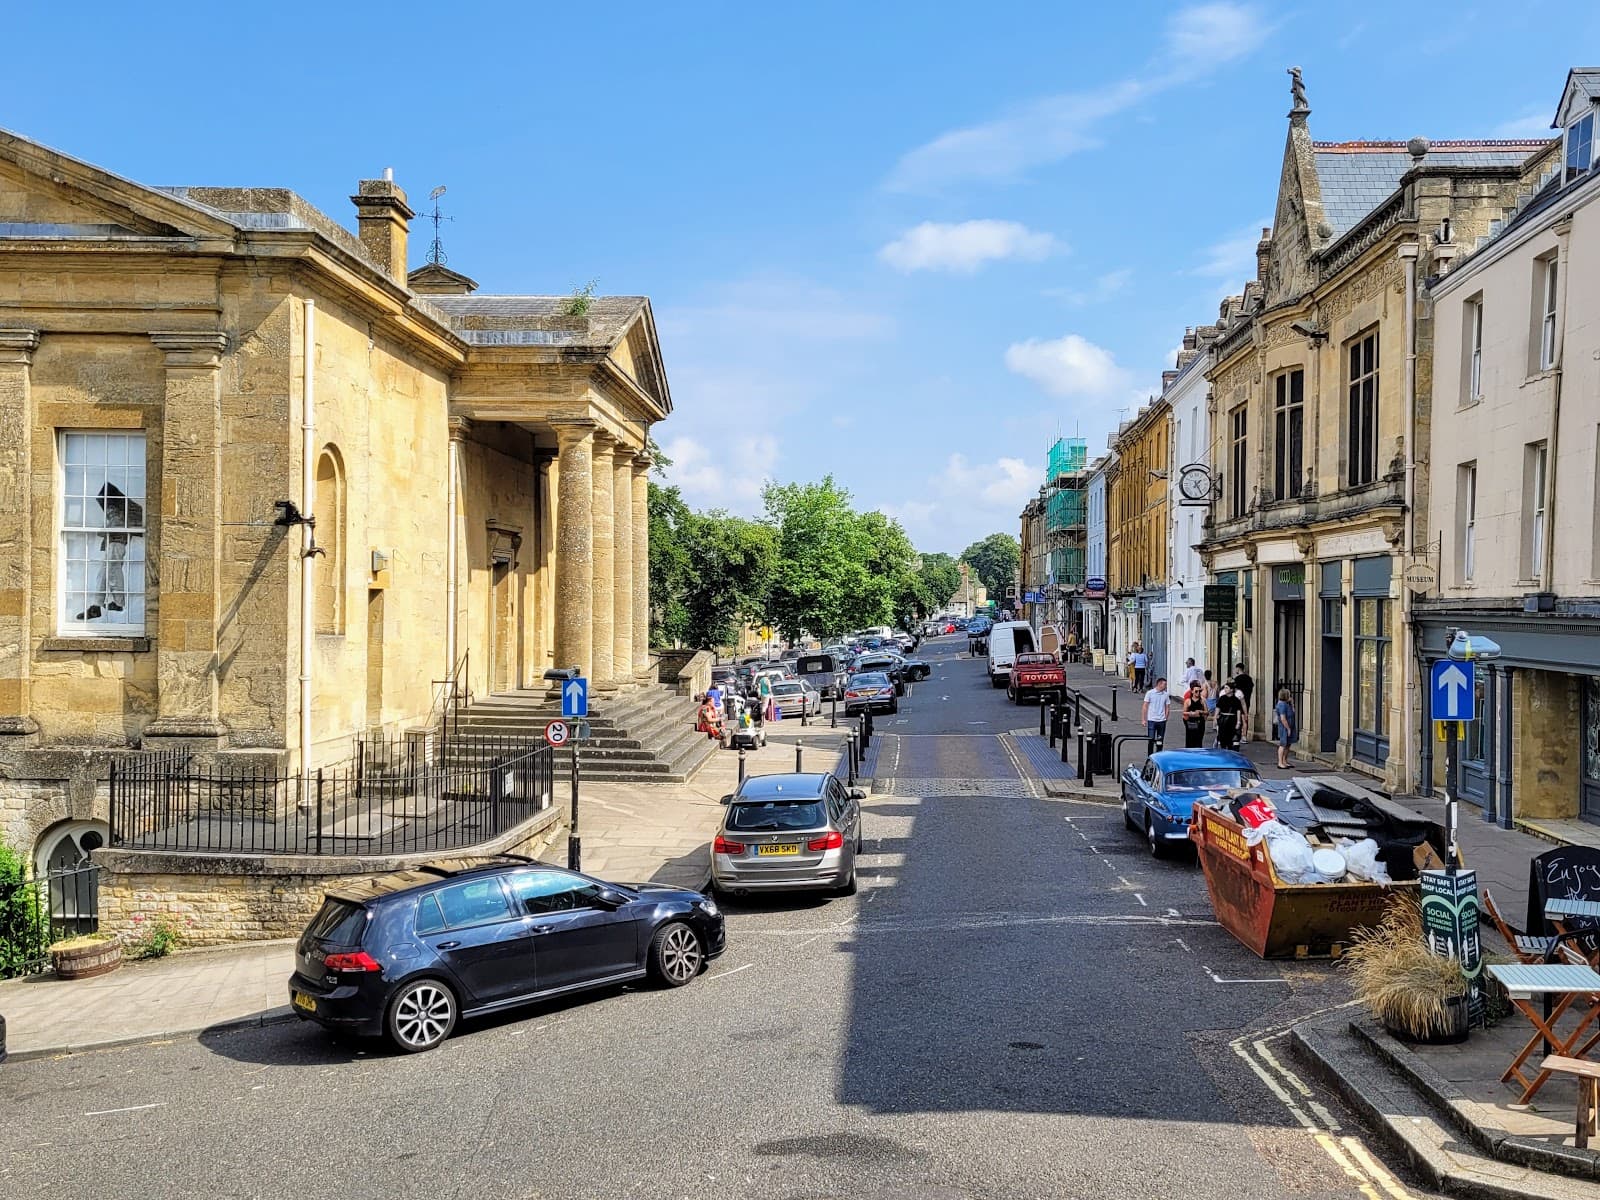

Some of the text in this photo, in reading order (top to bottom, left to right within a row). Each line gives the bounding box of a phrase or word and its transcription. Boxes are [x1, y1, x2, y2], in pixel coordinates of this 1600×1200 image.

[552, 724, 563, 741] 20
[1423, 875, 1436, 883] STAY
[1547, 857, 1600, 894] Enjoy
[1421, 883, 1455, 896] SHOP LOCAL
[1426, 907, 1452, 920] SOCIAL
